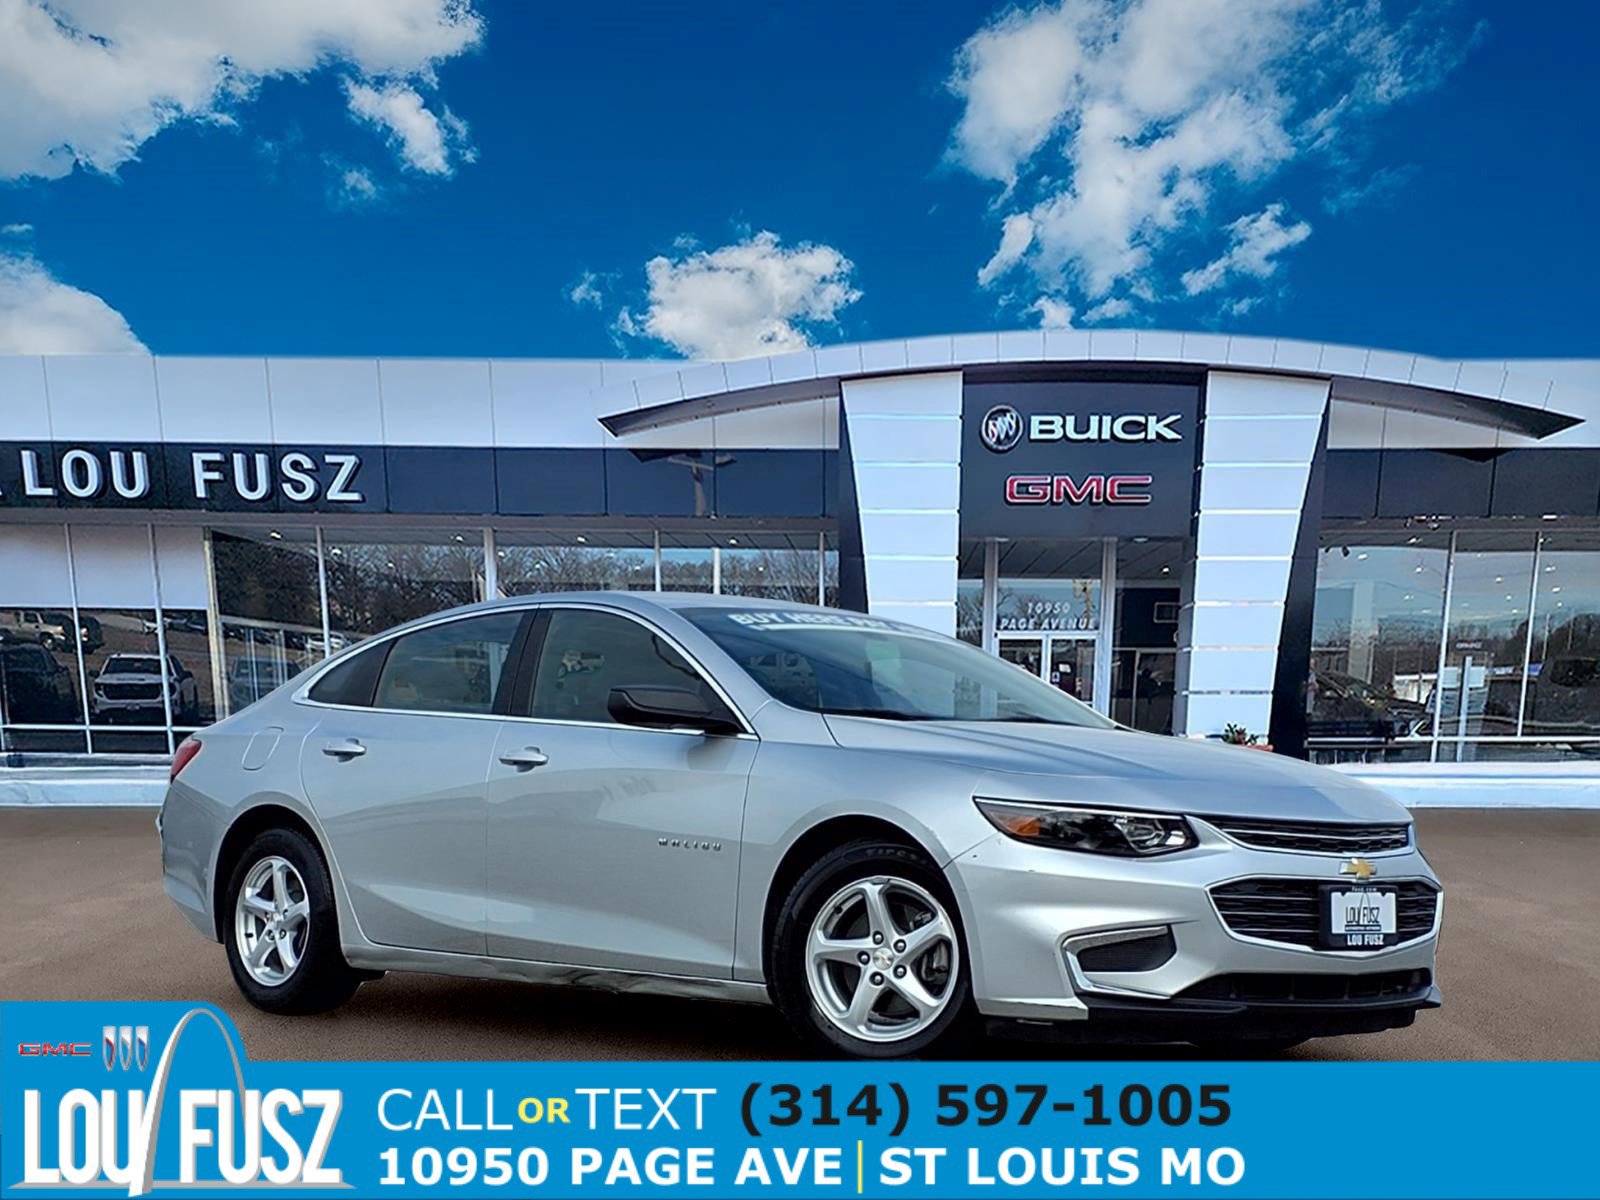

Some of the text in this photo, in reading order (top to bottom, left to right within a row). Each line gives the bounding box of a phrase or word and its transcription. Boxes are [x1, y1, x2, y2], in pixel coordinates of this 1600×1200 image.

[1029, 414, 1182, 440] BUICK
[20, 449, 364, 503] LOU FUSZ
[1006, 475, 1152, 503] GMC
[1027, 602, 1071, 614] 10950
[727, 613, 784, 625] BUY
[1000, 617, 1096, 630] PAGE AVENUE
[1346, 934, 1384, 946] LOU FUSZ
